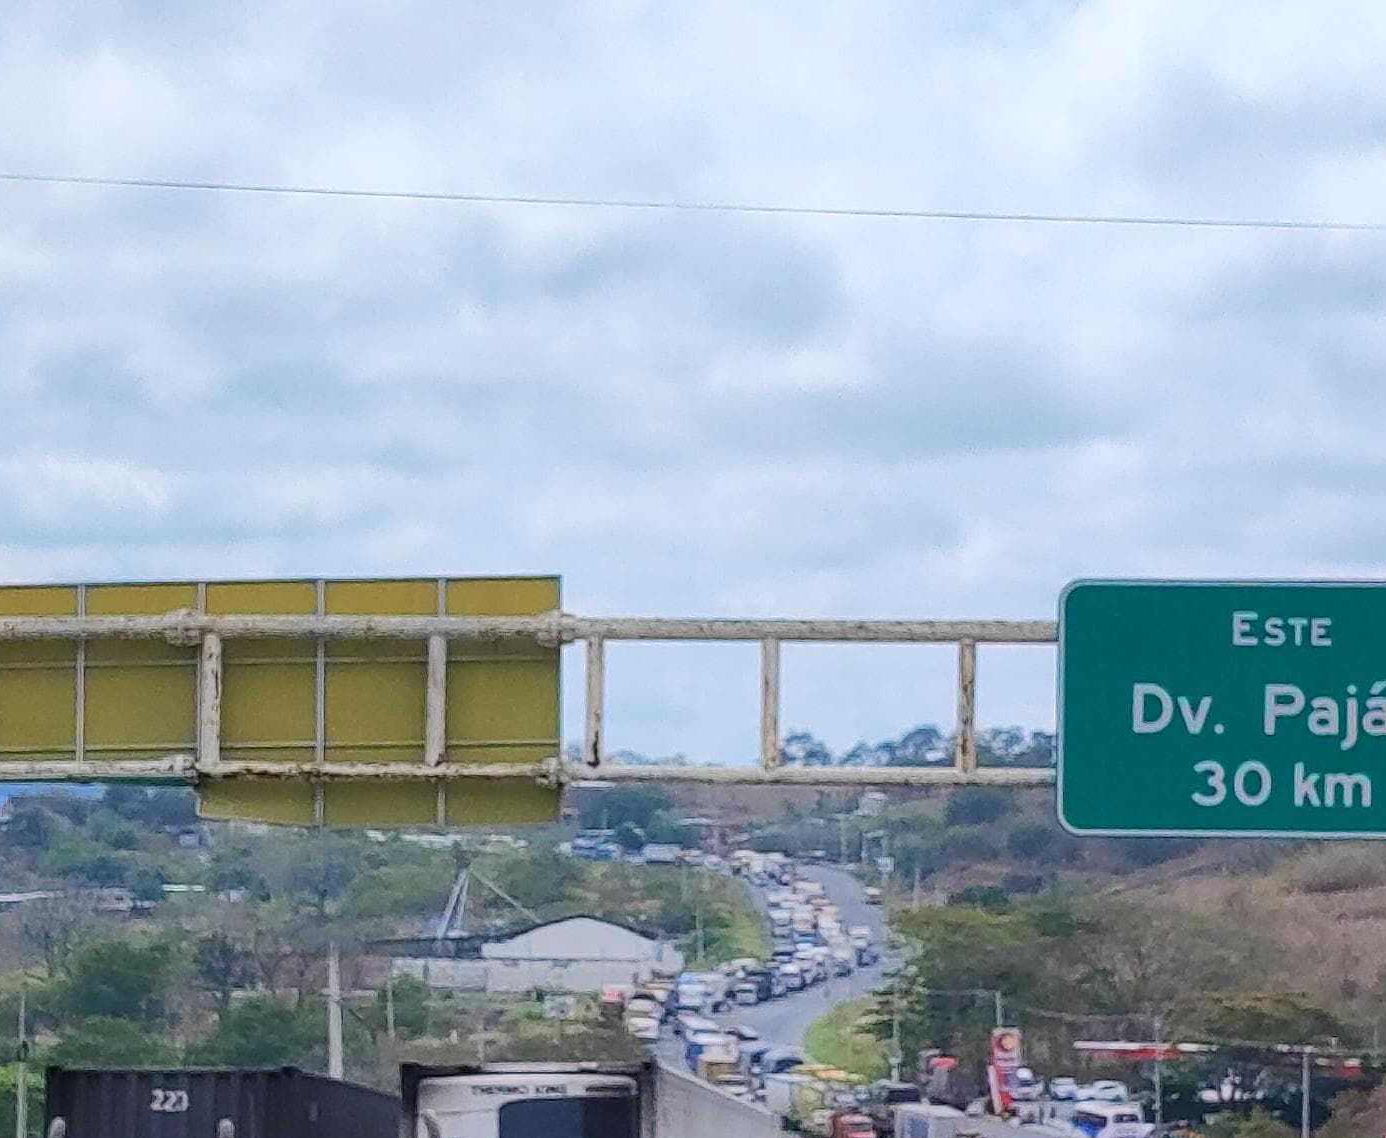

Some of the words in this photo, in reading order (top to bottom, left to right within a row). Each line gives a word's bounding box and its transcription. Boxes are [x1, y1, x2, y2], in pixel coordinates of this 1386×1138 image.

[1233, 612, 1333, 647] ESTE
[1131, 682, 1225, 736] Dv.
[1192, 762, 1272, 808] 30
[1293, 762, 1373, 808] km
